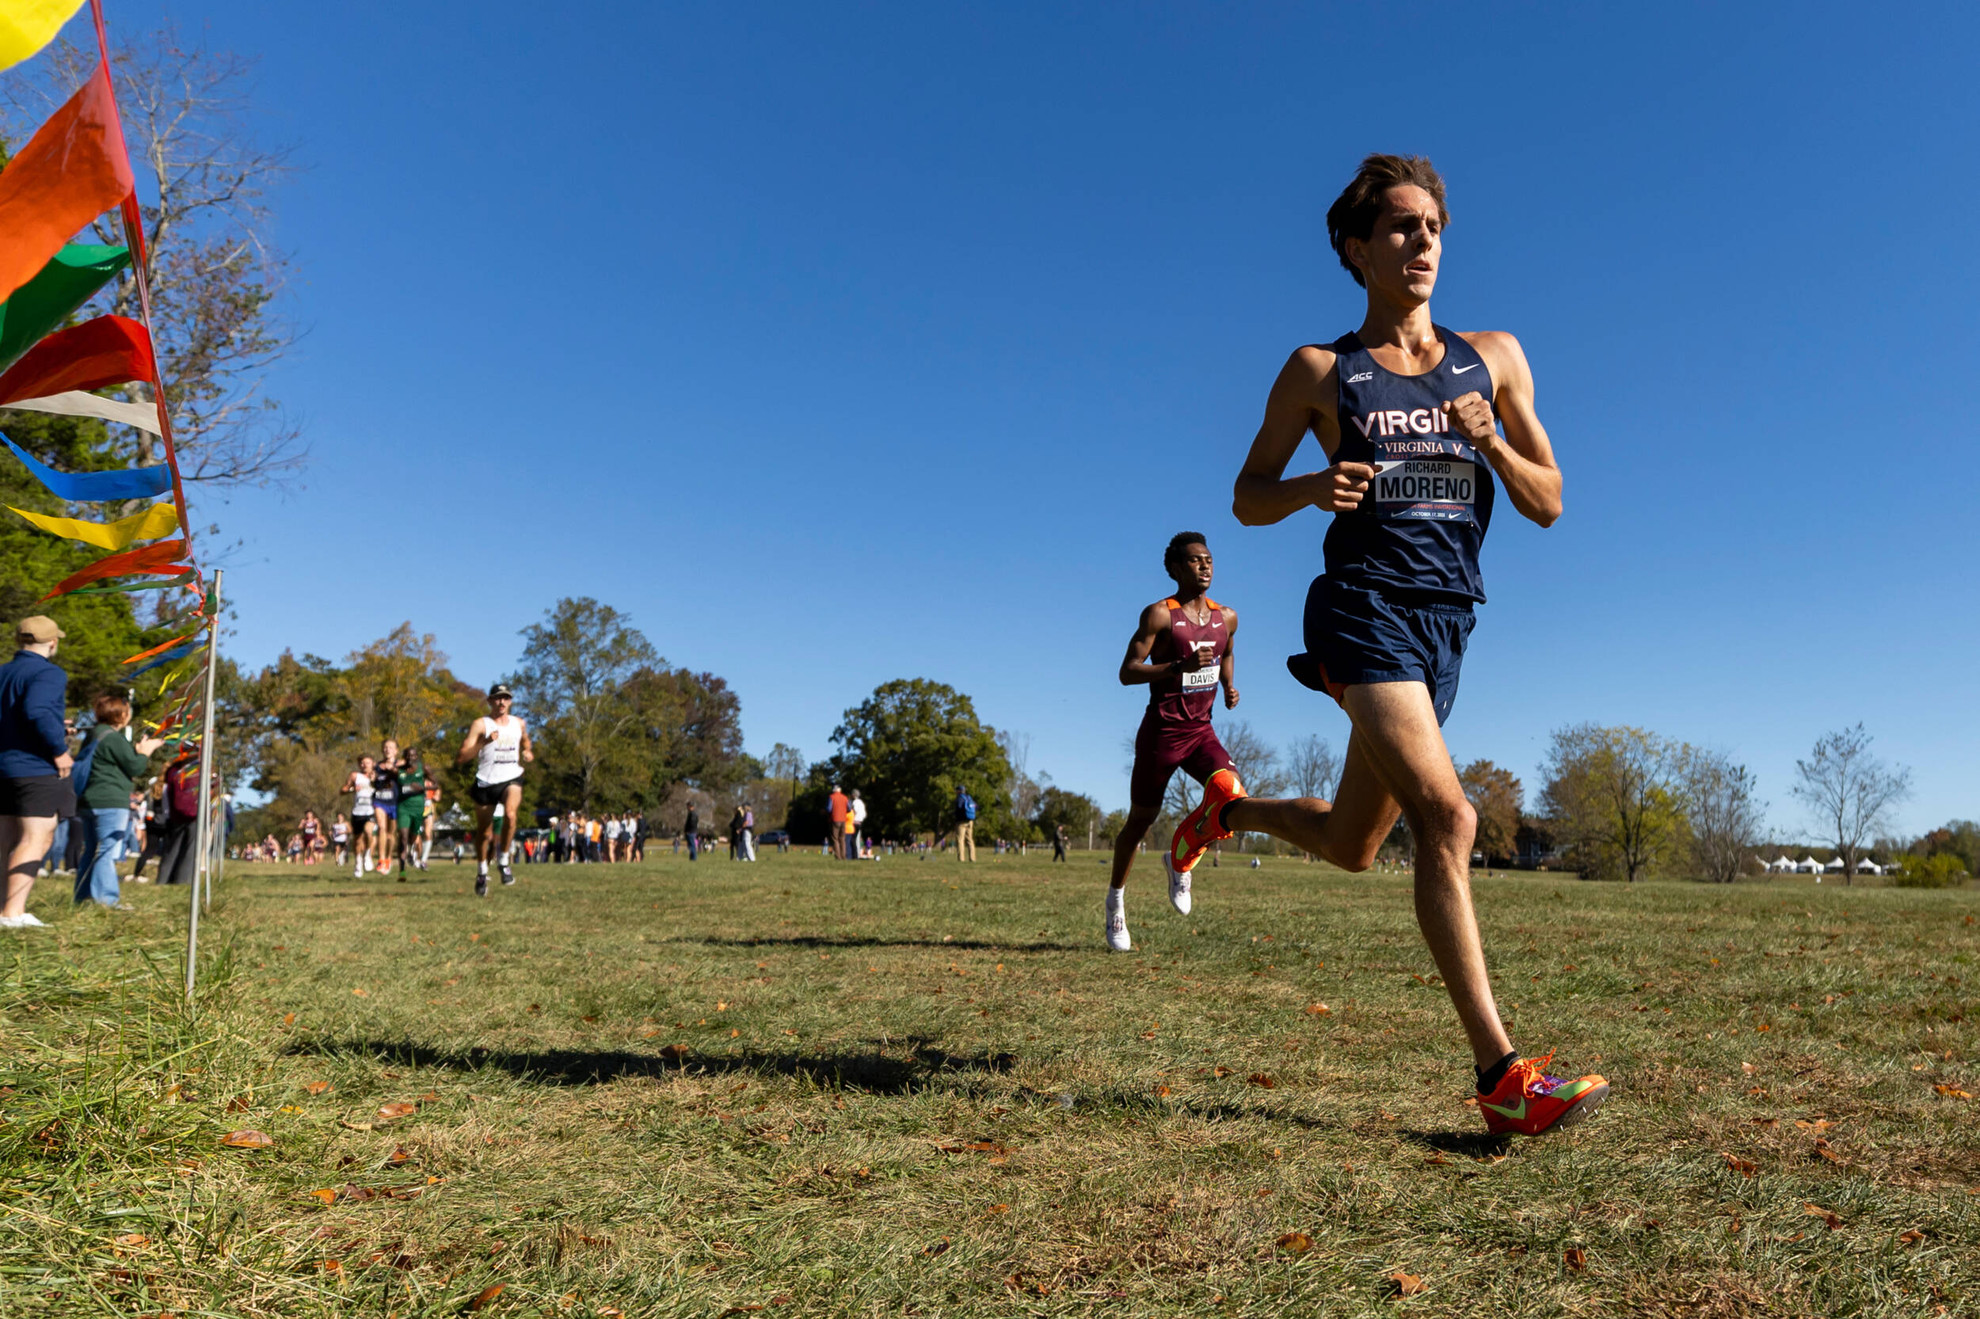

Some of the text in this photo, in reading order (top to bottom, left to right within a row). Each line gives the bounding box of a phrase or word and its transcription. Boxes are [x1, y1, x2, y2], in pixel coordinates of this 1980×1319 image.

[1347, 372, 1373, 383] ACC
[1384, 441, 1445, 453] VIRGINIA
[1404, 462, 1451, 474] RICHARD
[1380, 476, 1471, 501] MORENO
[1190, 673, 1214, 684] DAVIS
